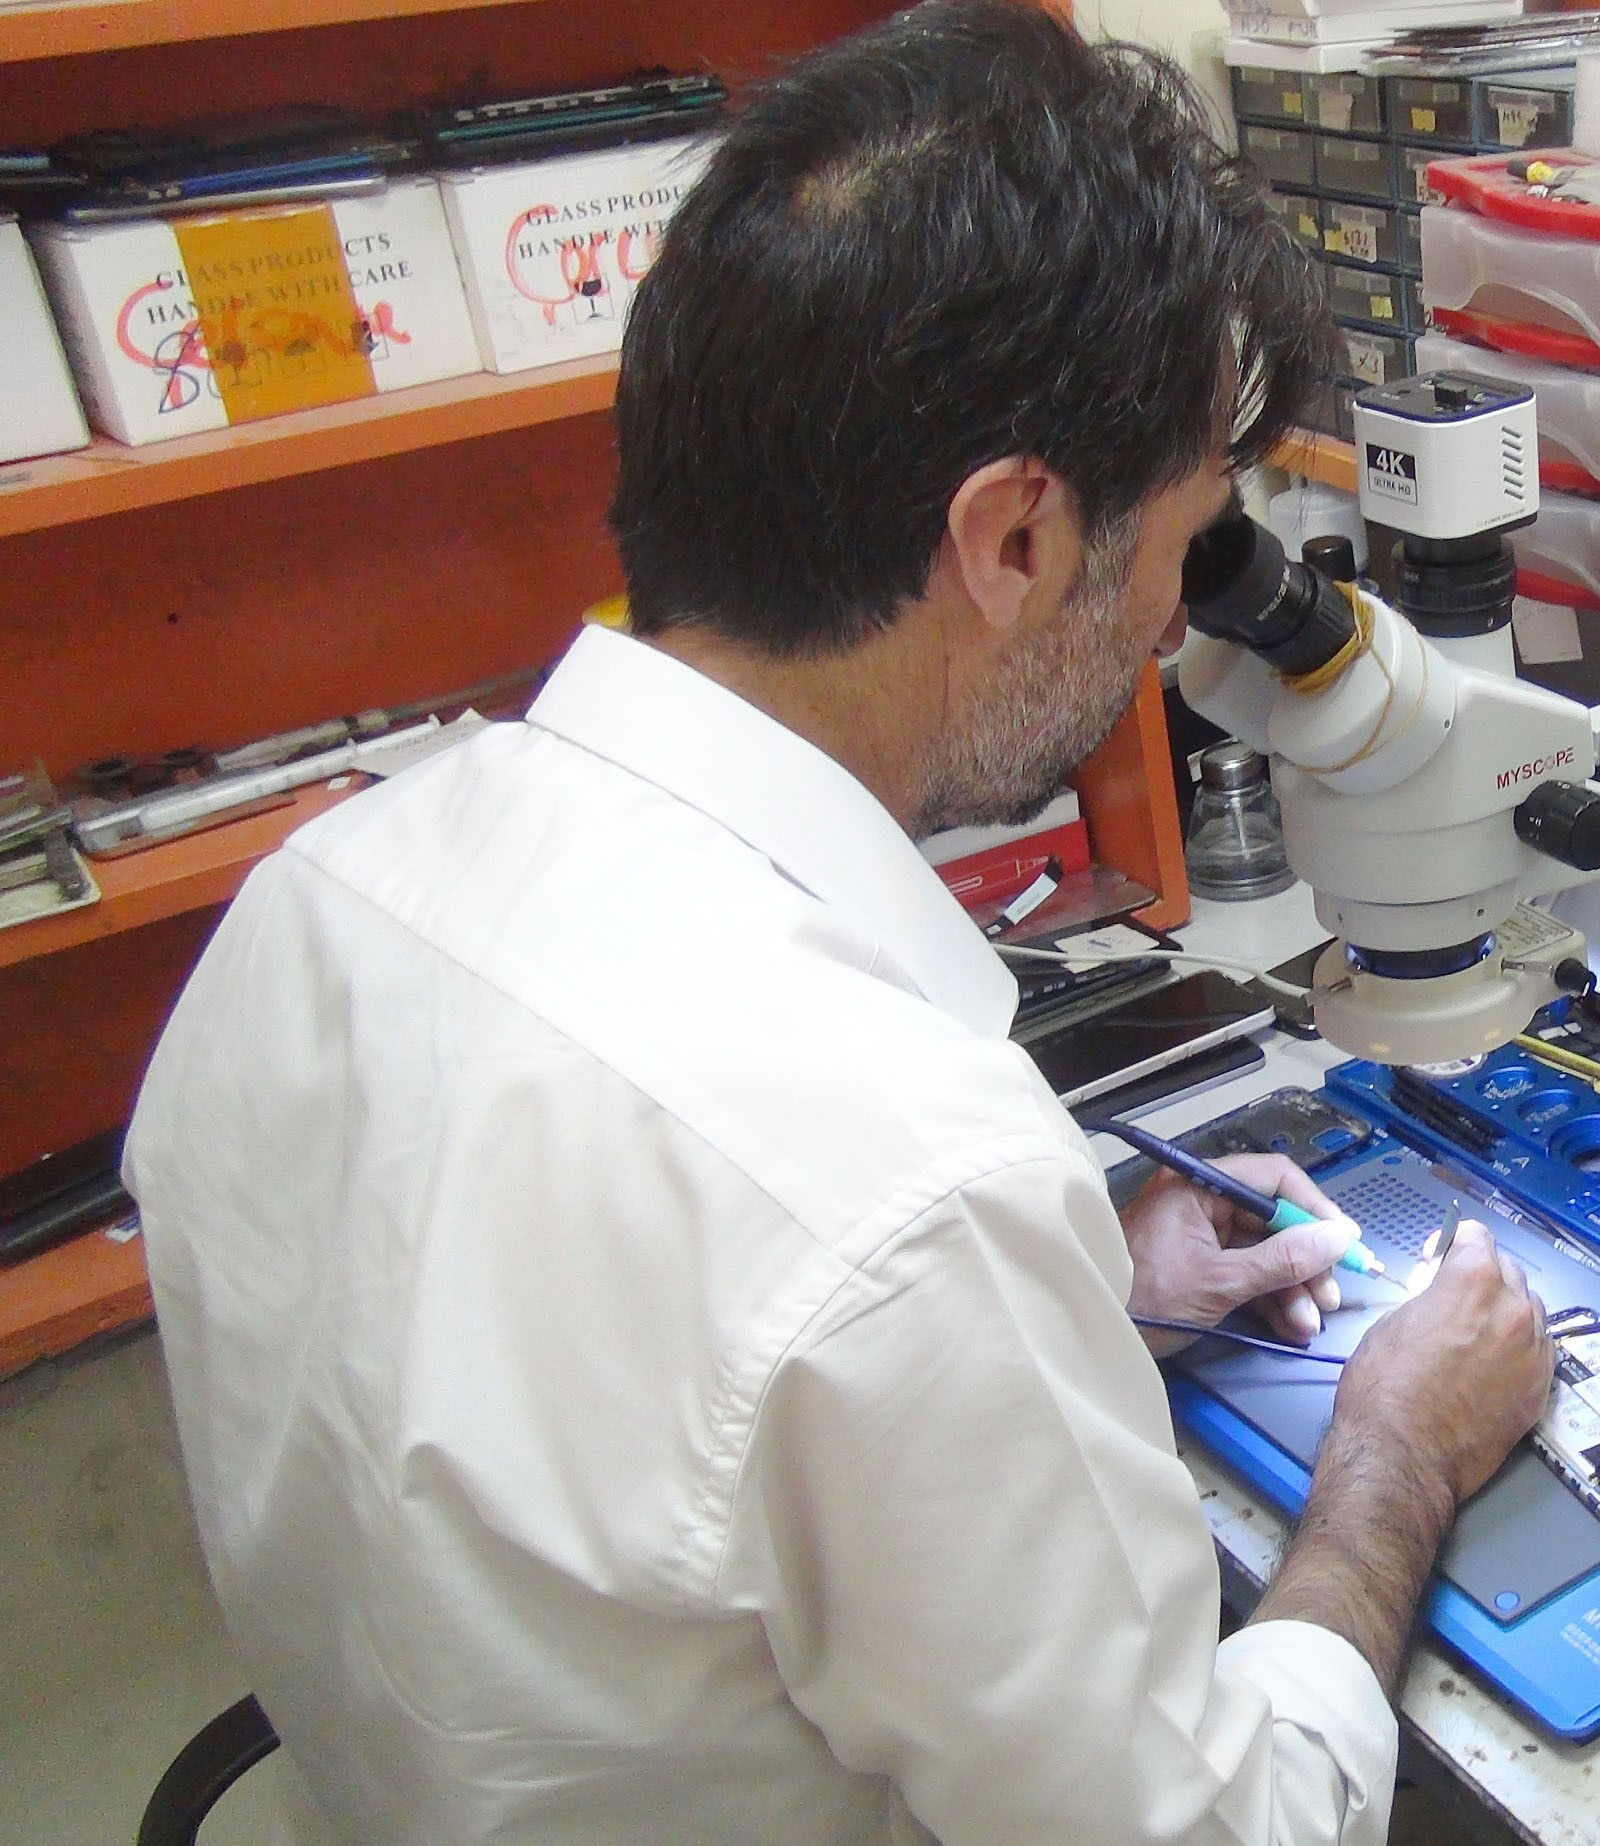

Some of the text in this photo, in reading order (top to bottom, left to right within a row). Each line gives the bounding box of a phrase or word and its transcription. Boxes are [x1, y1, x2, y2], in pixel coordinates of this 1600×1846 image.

[526, 199, 602, 226] GLASS
[156, 231, 393, 288] GLASS PRODUCTS
[518, 216, 668, 260] HANDLE WIT
[147, 258, 414, 326] HANDLE WITH CARE
[1376, 448, 1406, 478] 4K
[1373, 476, 1411, 496] ULTRA HD
[1496, 745, 1575, 790] MYSCOPE
